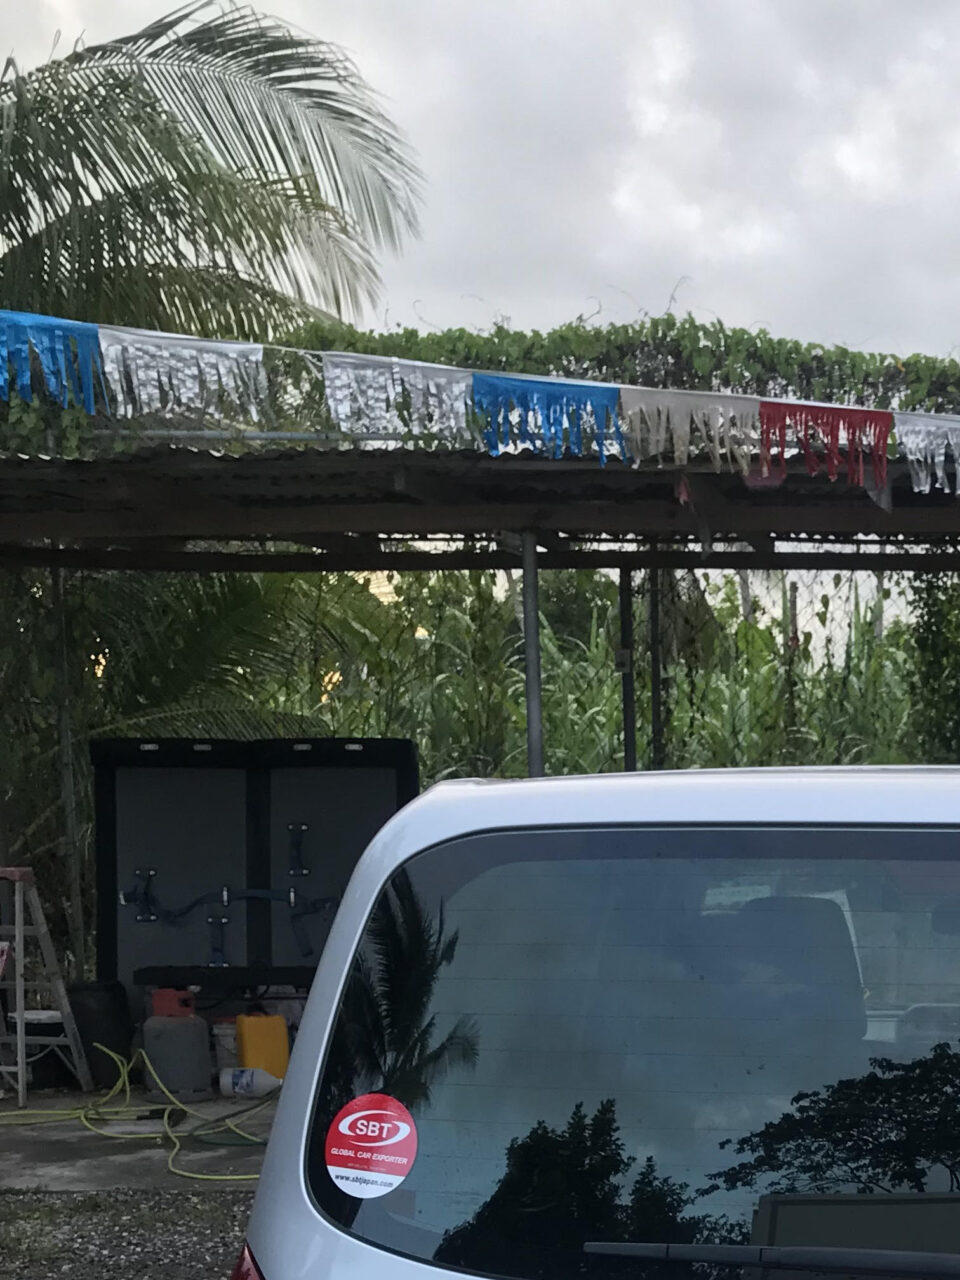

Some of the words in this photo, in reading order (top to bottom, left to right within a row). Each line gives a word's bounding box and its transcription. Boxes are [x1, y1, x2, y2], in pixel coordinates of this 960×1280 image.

[356, 1119, 393, 1138] SBT
[331, 1147, 355, 1157] GLOBAL
[357, 1151, 371, 1159] CAR
[372, 1153, 408, 1165] EXPORTER
[334, 1174, 394, 1188] www.sbtjapan.com
